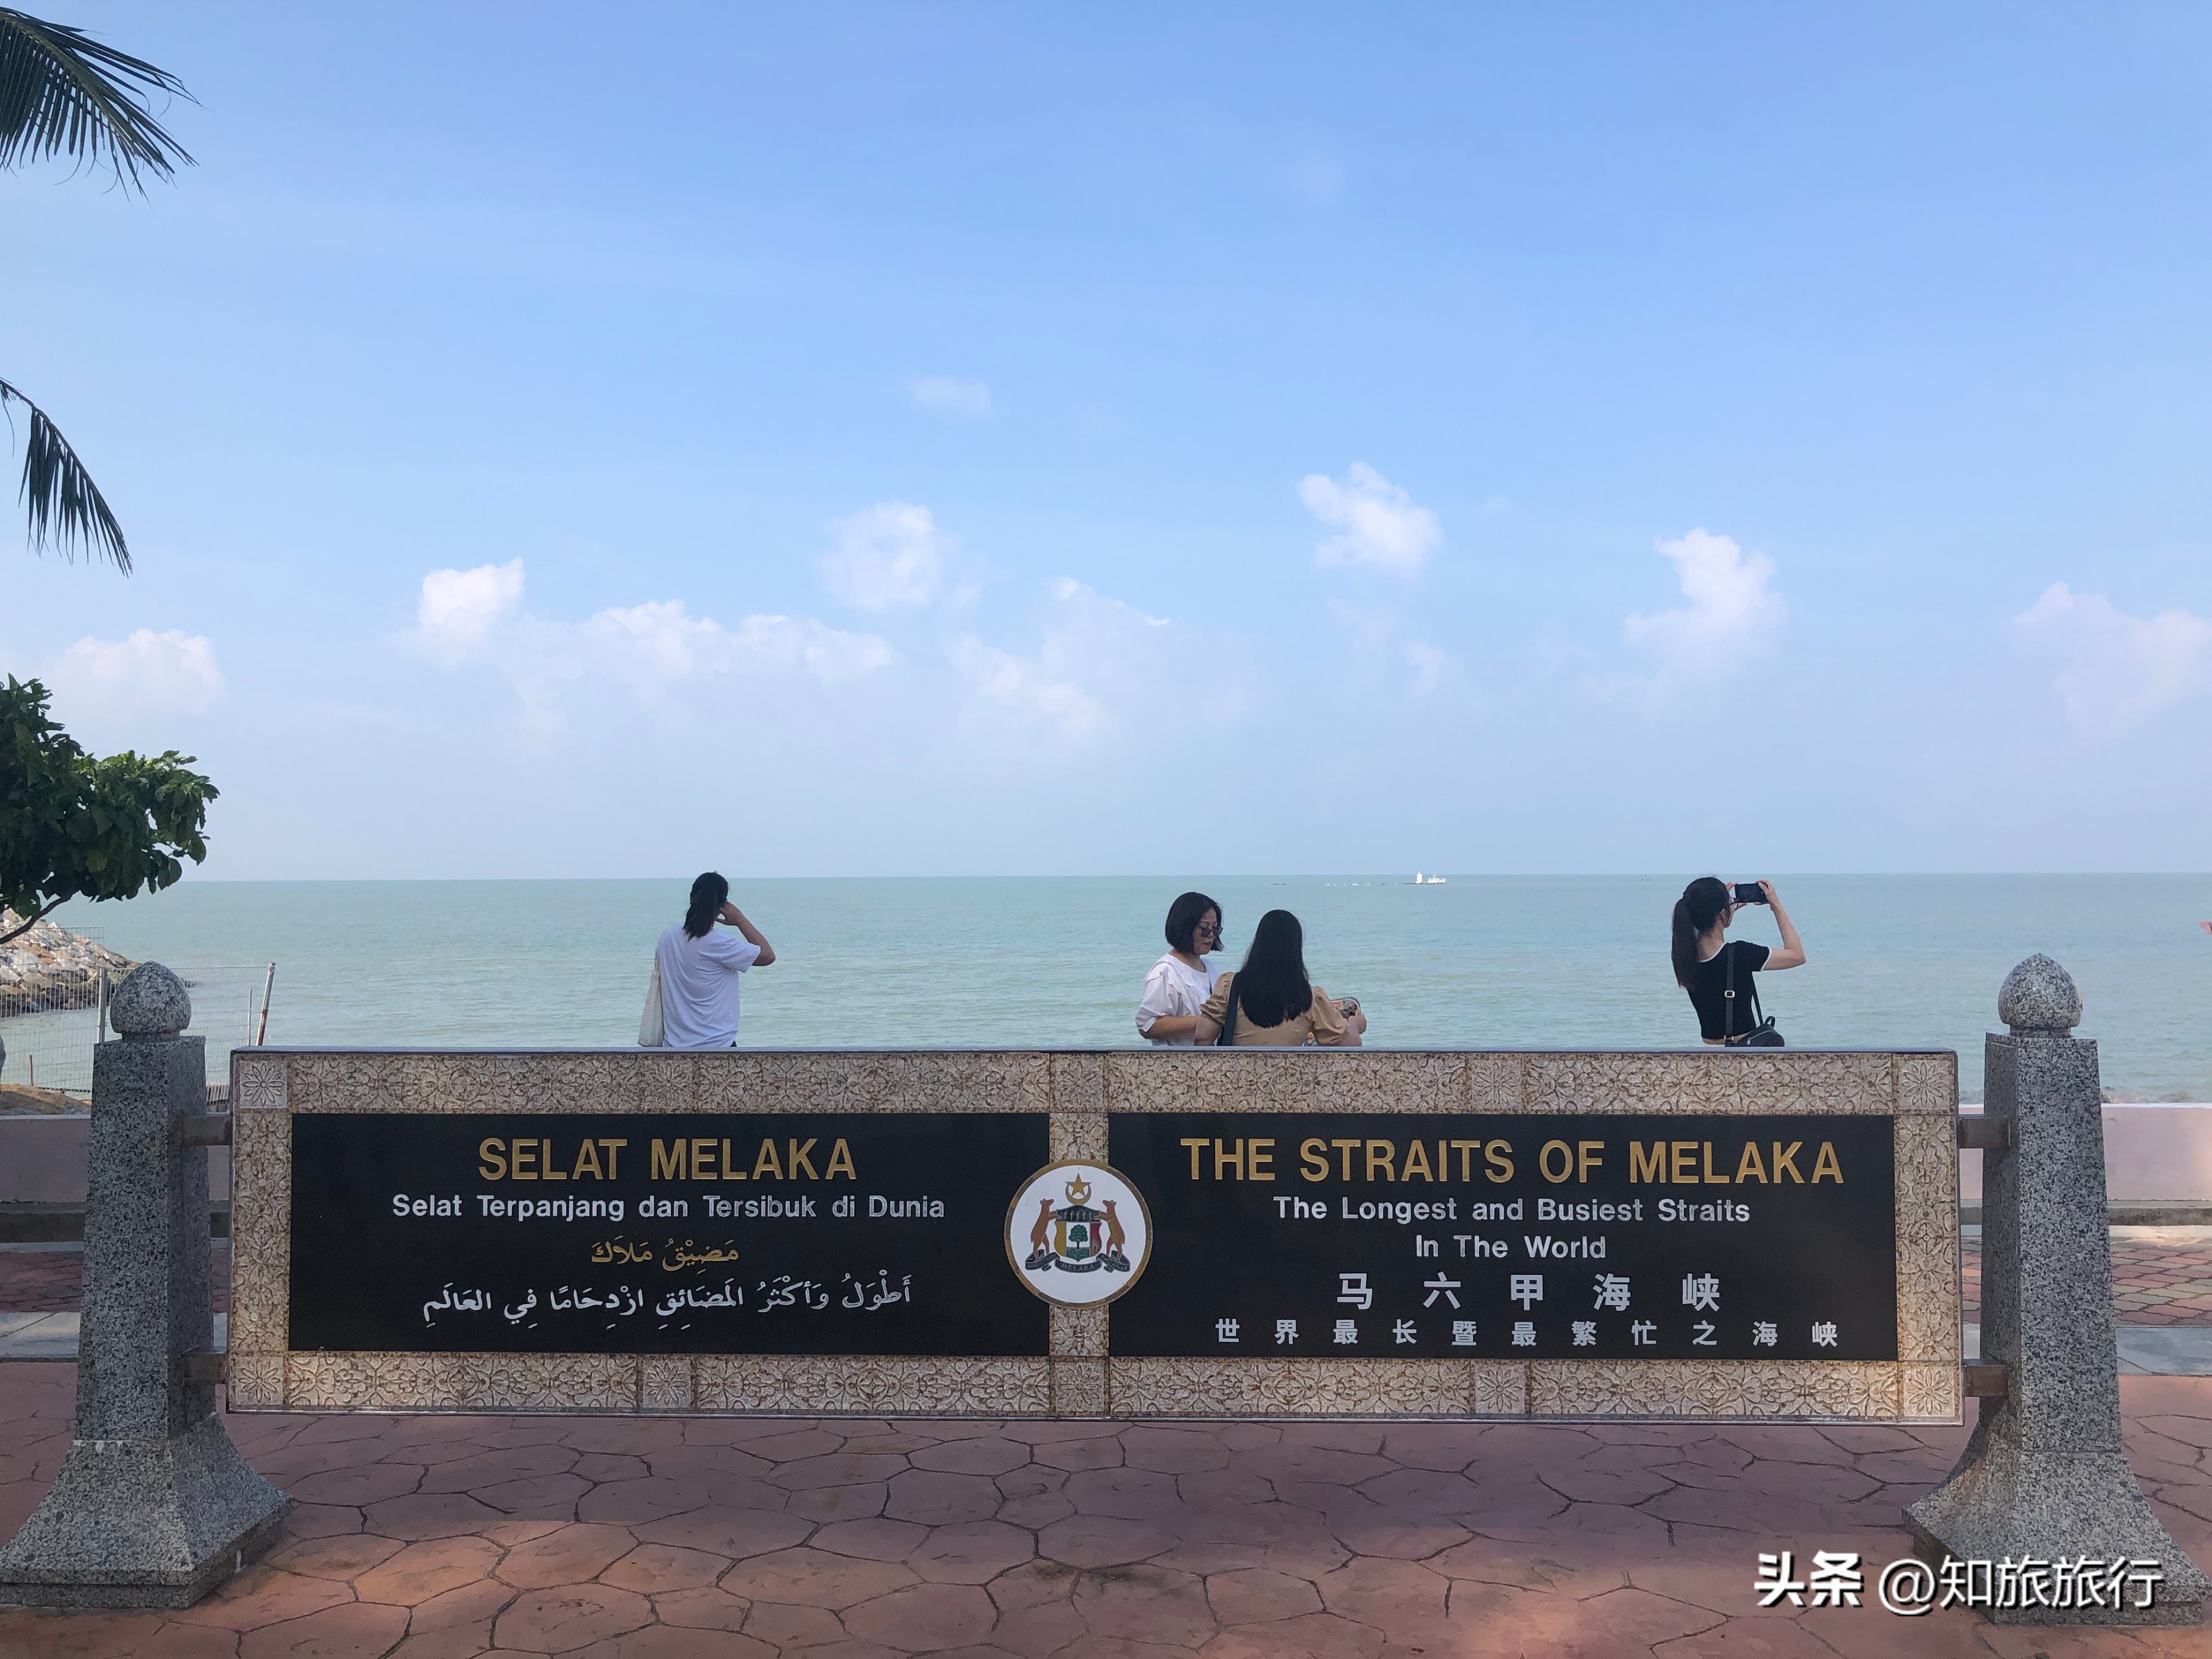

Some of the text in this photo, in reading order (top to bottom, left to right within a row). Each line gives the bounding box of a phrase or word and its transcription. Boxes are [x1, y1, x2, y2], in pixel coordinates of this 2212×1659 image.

[479, 1138, 856, 1180] SELAT MELAKA
[1181, 1138, 1843, 1183] THE STRAITS OF MELAKA
[393, 1194, 944, 1221] Selat Terpanjang dan Tersibuk di Dunia
[1274, 1196, 1749, 1224] The Longest and Busiest Straits
[1416, 1235, 1606, 1258] In The World
[1061, 1263, 1095, 1271] MELAKA
